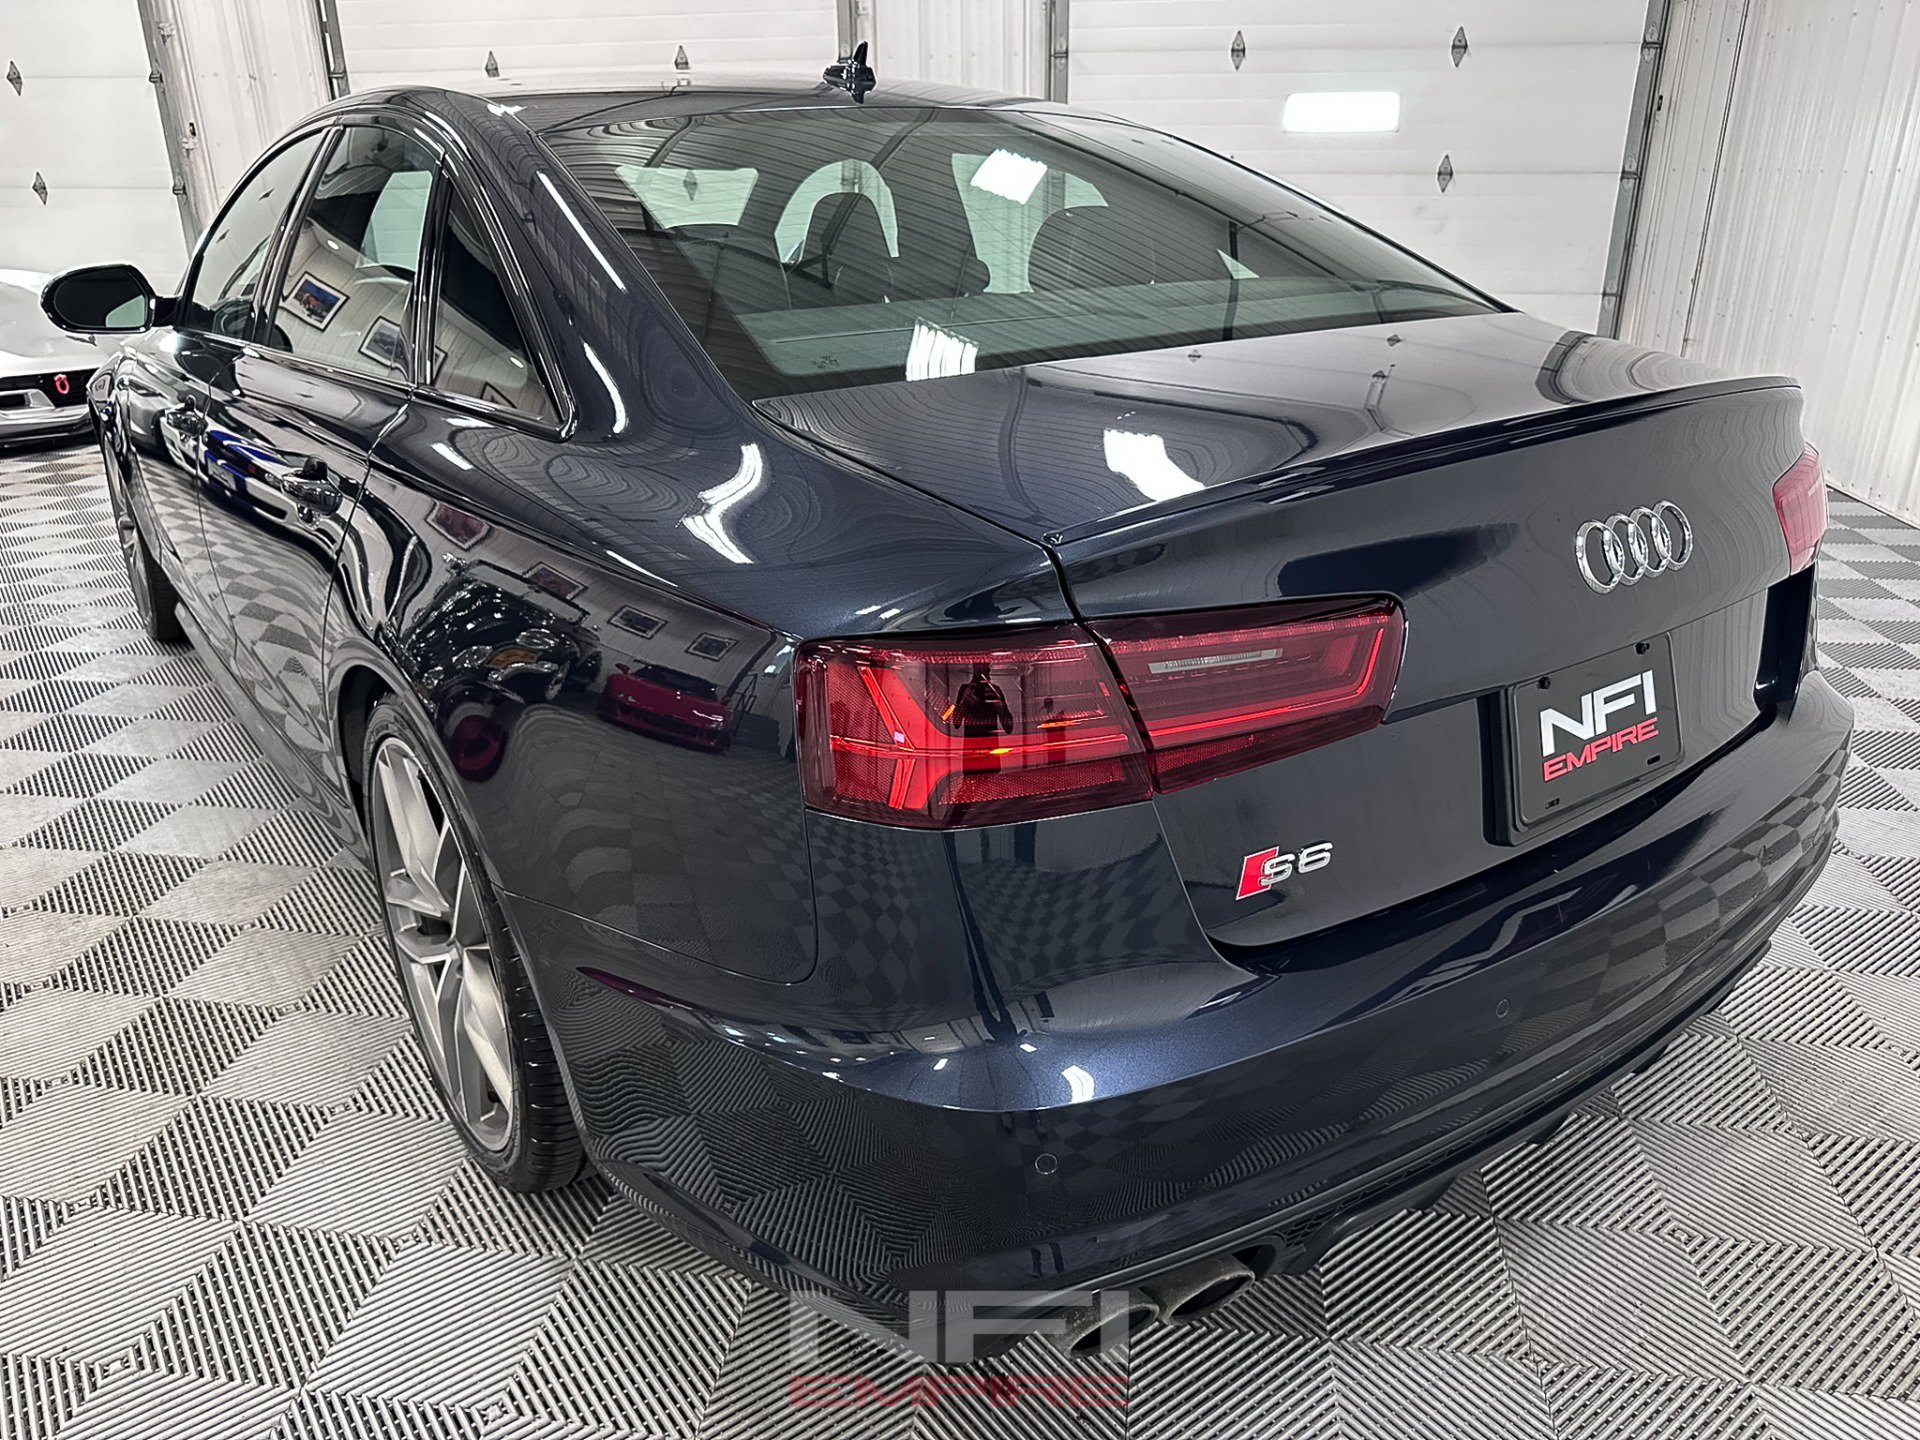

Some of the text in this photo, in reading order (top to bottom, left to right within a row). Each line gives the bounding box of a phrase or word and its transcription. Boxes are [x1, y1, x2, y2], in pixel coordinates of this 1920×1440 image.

[1539, 669, 1656, 758] NFI
[1543, 716, 1659, 782] EMPIRE
[1259, 842, 1333, 886] S6
